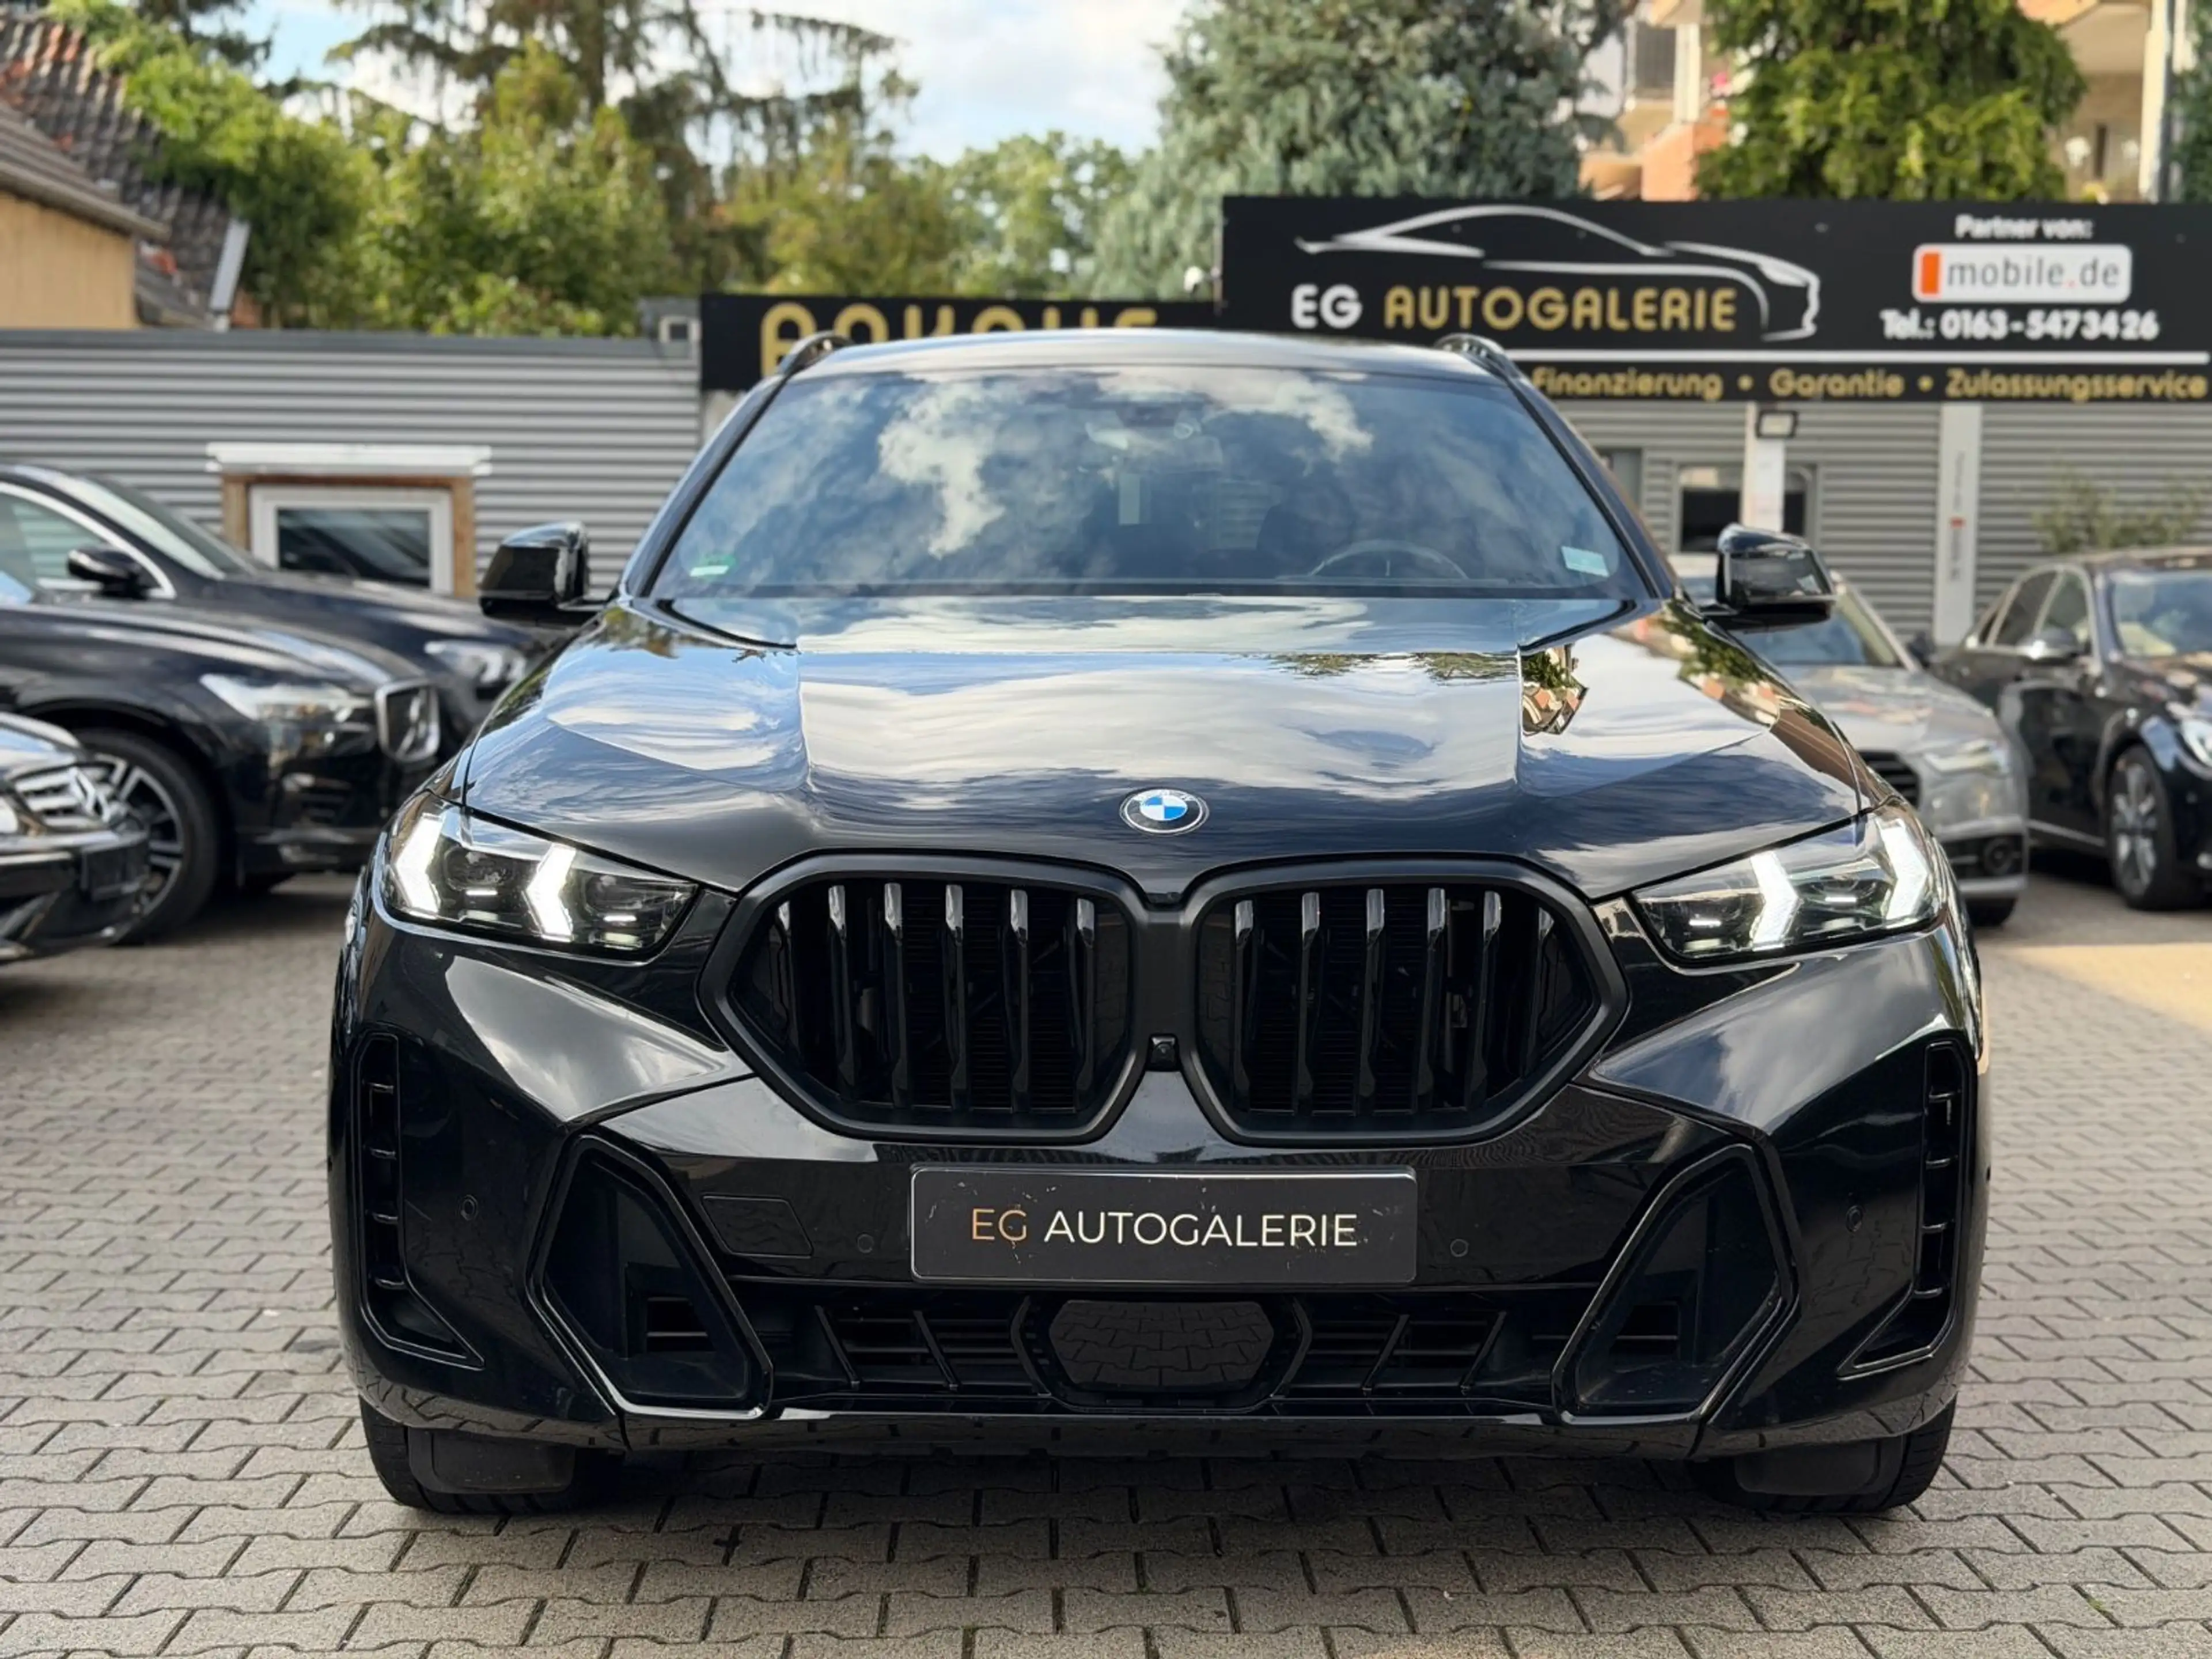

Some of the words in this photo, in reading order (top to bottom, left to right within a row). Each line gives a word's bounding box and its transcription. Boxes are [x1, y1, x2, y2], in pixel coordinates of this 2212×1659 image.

[1955, 214, 2039, 239] Partner
[2041, 218, 2093, 239] von:
[1947, 257, 2119, 287] mobile.de
[1291, 284, 1363, 329] EG
[1384, 286, 1737, 331] AUTOGALERIE
[1880, 308, 1936, 340] Tel.:
[1532, 367, 1723, 402] Finanzierung
[1769, 369, 1904, 399] Garantie
[1943, 369, 2209, 402] Zulassungsservice
[971, 1208, 1027, 1241] EG
[1043, 1210, 1358, 1247] AUTOGALERIE
